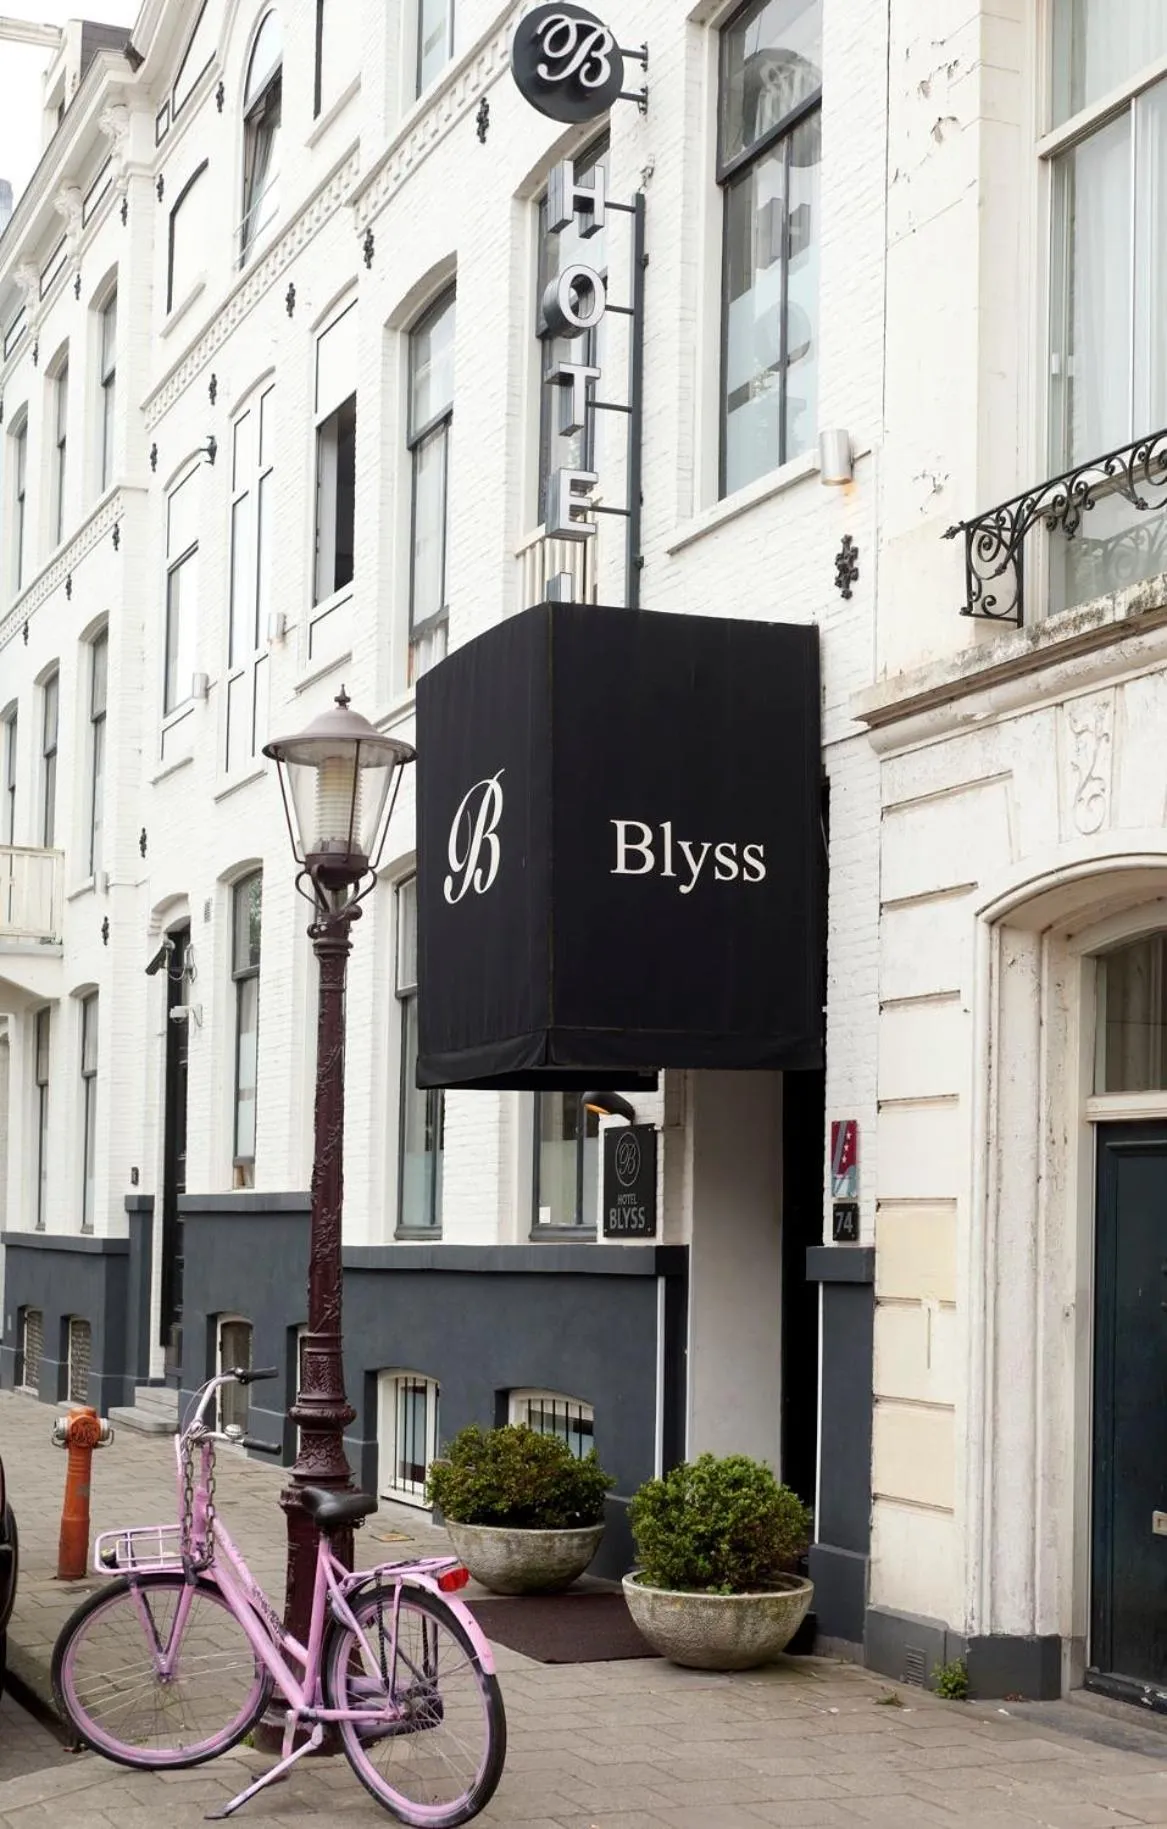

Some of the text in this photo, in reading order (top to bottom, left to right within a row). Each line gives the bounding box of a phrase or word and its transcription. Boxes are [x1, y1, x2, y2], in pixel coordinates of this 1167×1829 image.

[535, 14, 612, 88] B
[444, 768, 506, 904] B
[610, 820, 767, 894] Blyss
[609, 1207, 646, 1229] BLYSS
[618, 1193, 638, 1205] HOTEL
[835, 1211, 853, 1233] 74
